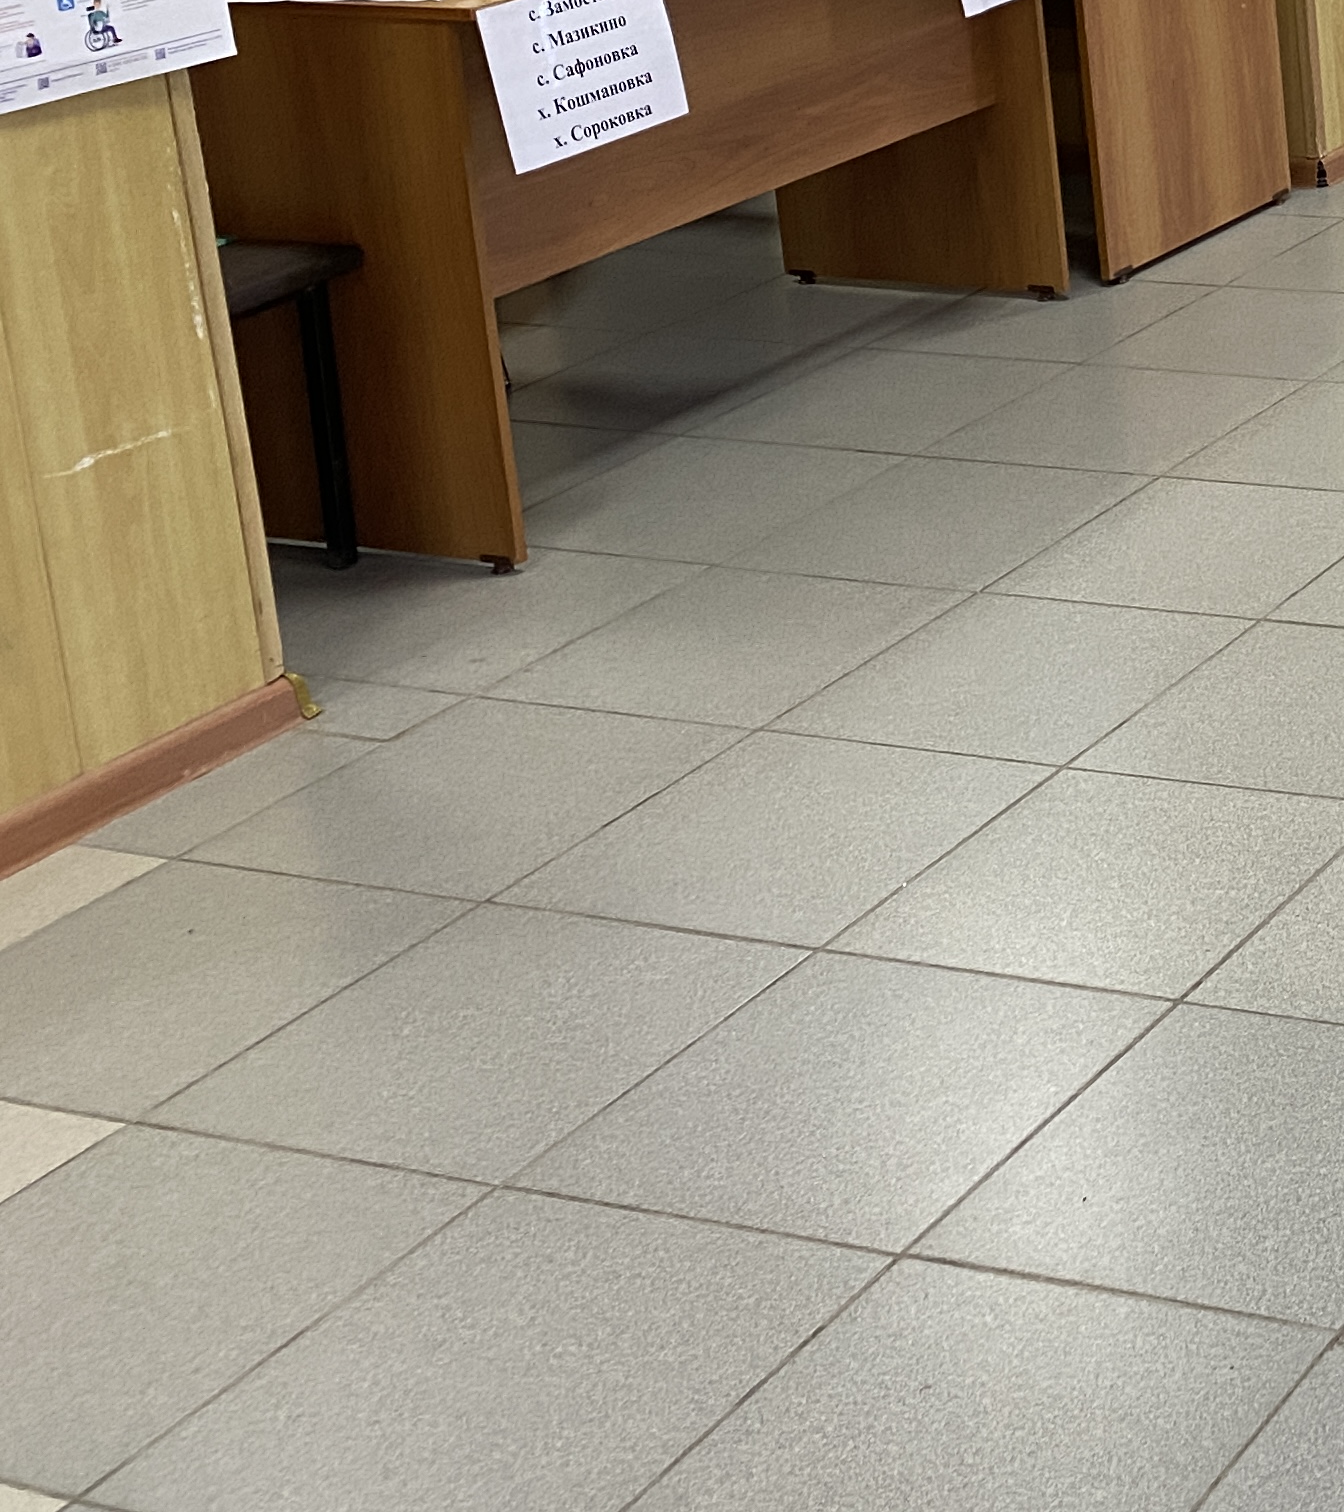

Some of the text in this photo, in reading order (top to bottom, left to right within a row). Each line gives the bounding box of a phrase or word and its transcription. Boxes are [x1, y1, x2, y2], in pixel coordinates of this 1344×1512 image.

[528, 9, 541, 22] с.
[532, 15, 627, 54] с. Мазикино
[537, 44, 638, 86] с. Сафоновка
[538, 71, 653, 120] х. Кошмановка
[554, 104, 653, 149] х. Сороковка
